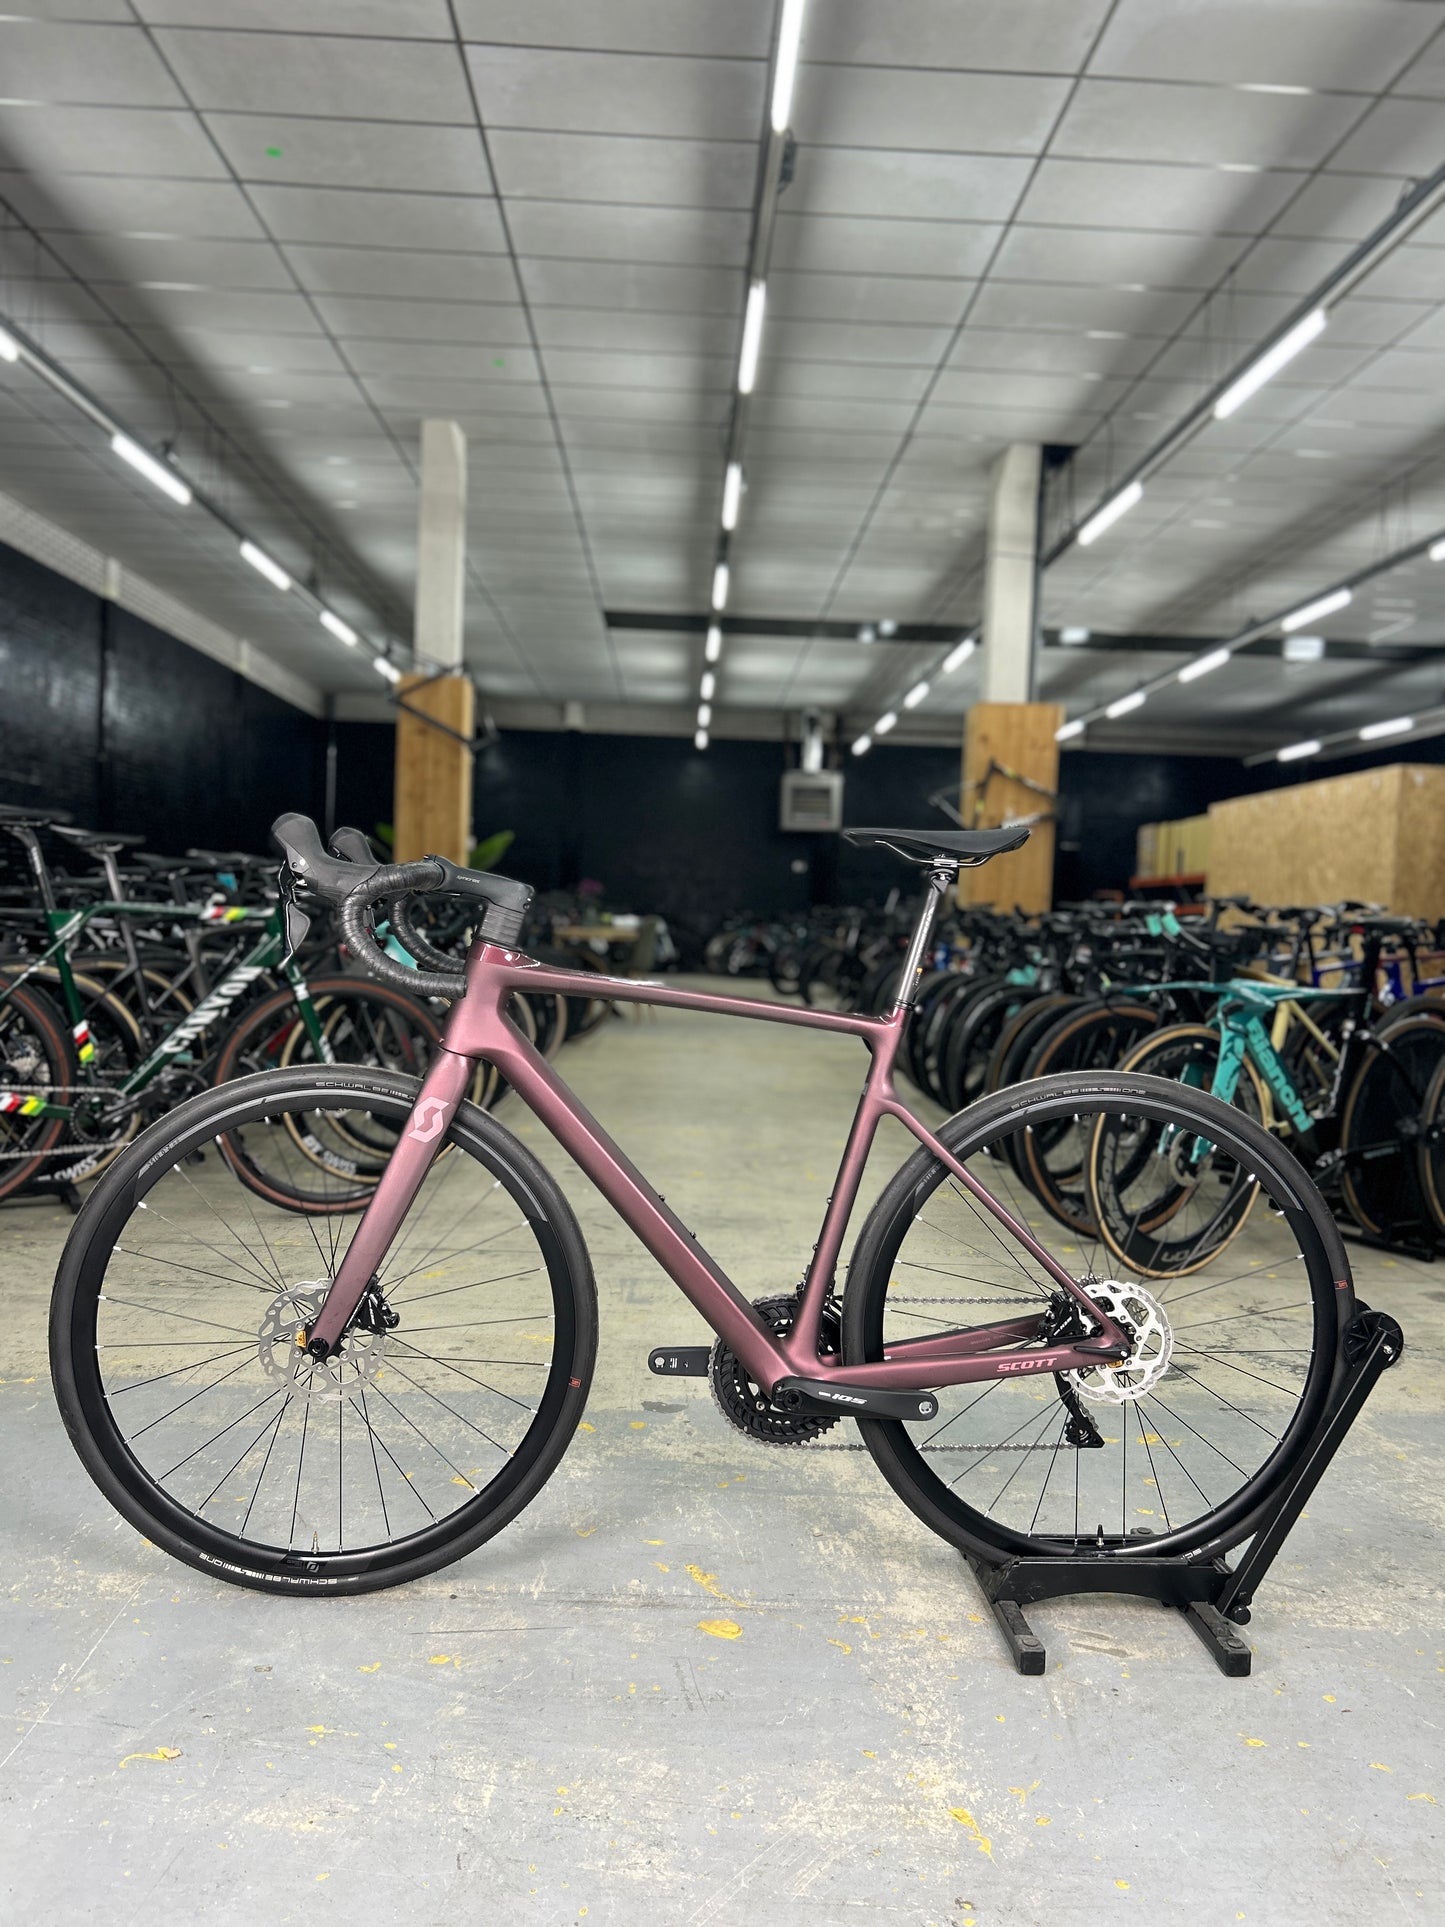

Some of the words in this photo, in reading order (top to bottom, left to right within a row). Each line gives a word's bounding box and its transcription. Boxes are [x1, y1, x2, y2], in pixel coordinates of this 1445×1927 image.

[1246, 1016, 1316, 1133] Bianchi
[315, 1081, 389, 1094] SCHWALBE
[1010, 1088, 1080, 1110] SCHWALBE
[1121, 1087, 1146, 1095] ONE
[996, 1357, 1058, 1373] SCOTT
[831, 1393, 868, 1405] 105
[198, 1551, 224, 1567] ONE
[264, 1573, 338, 1586] SCHWALBE
